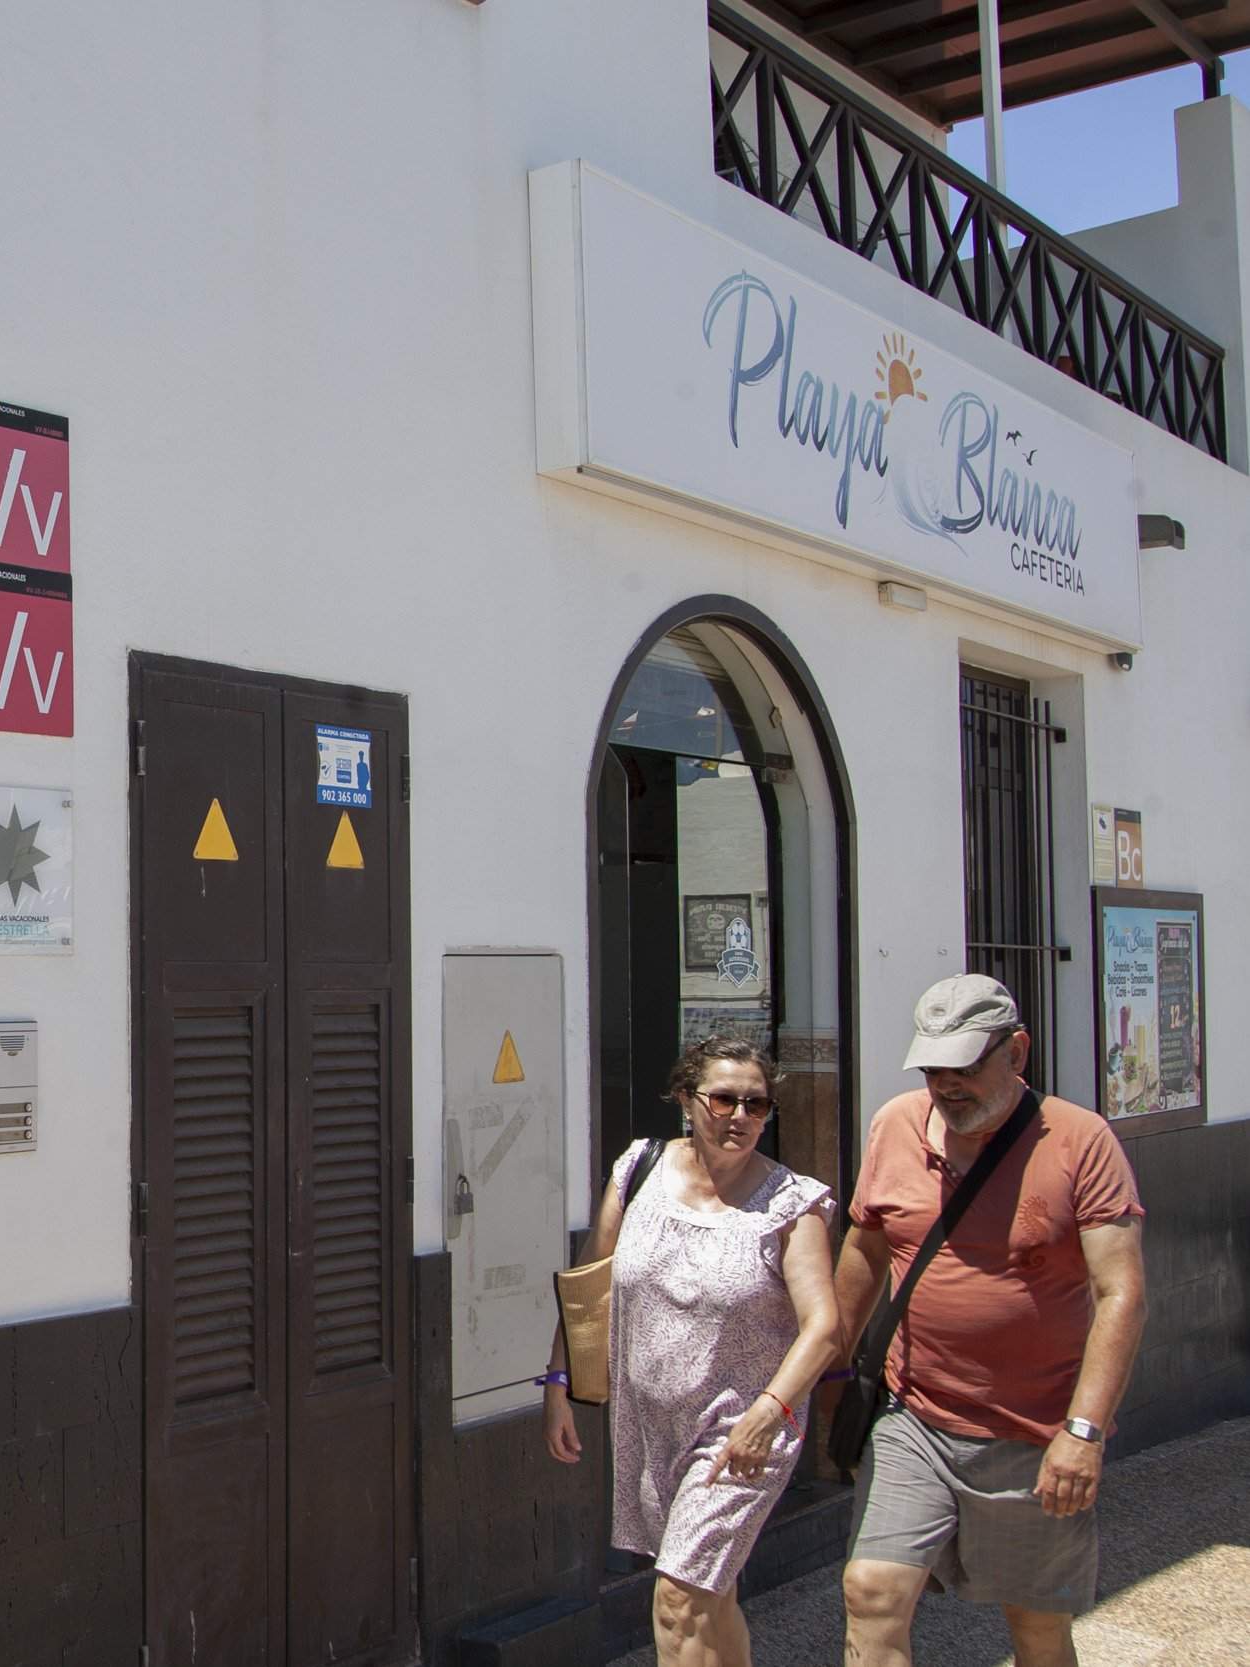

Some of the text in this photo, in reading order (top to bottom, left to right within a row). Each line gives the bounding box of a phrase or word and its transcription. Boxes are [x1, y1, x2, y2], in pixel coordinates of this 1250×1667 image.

[703, 269, 1083, 560] Playa Blanca
[318, 728, 338, 736] ALARMA
[322, 790, 366, 804] 902 365 000
